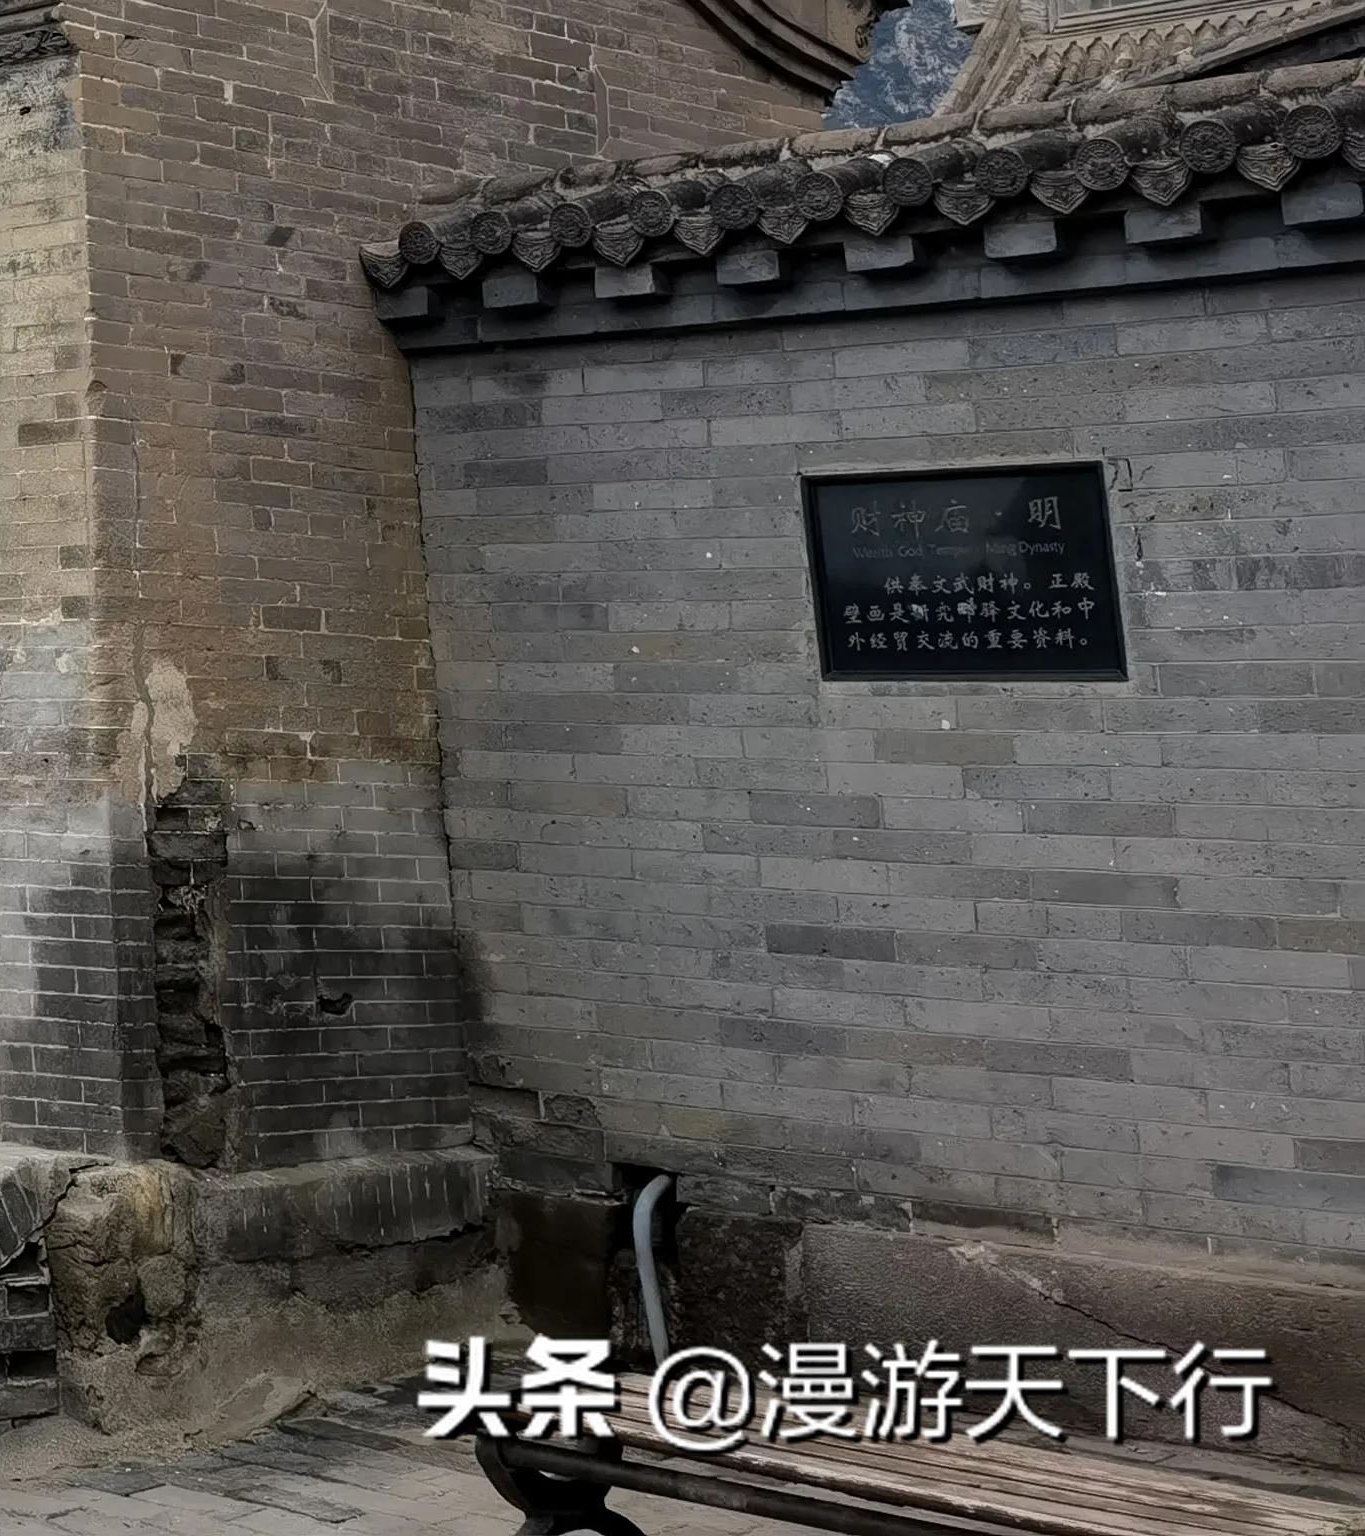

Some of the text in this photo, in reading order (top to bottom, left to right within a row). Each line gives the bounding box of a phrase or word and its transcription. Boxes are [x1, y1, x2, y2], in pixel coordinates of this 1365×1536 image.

[897, 544, 925, 559] God
[1018, 539, 1065, 556] Dynasty
[846, 627, 1090, 652] 外经贸交流的重要资料。
